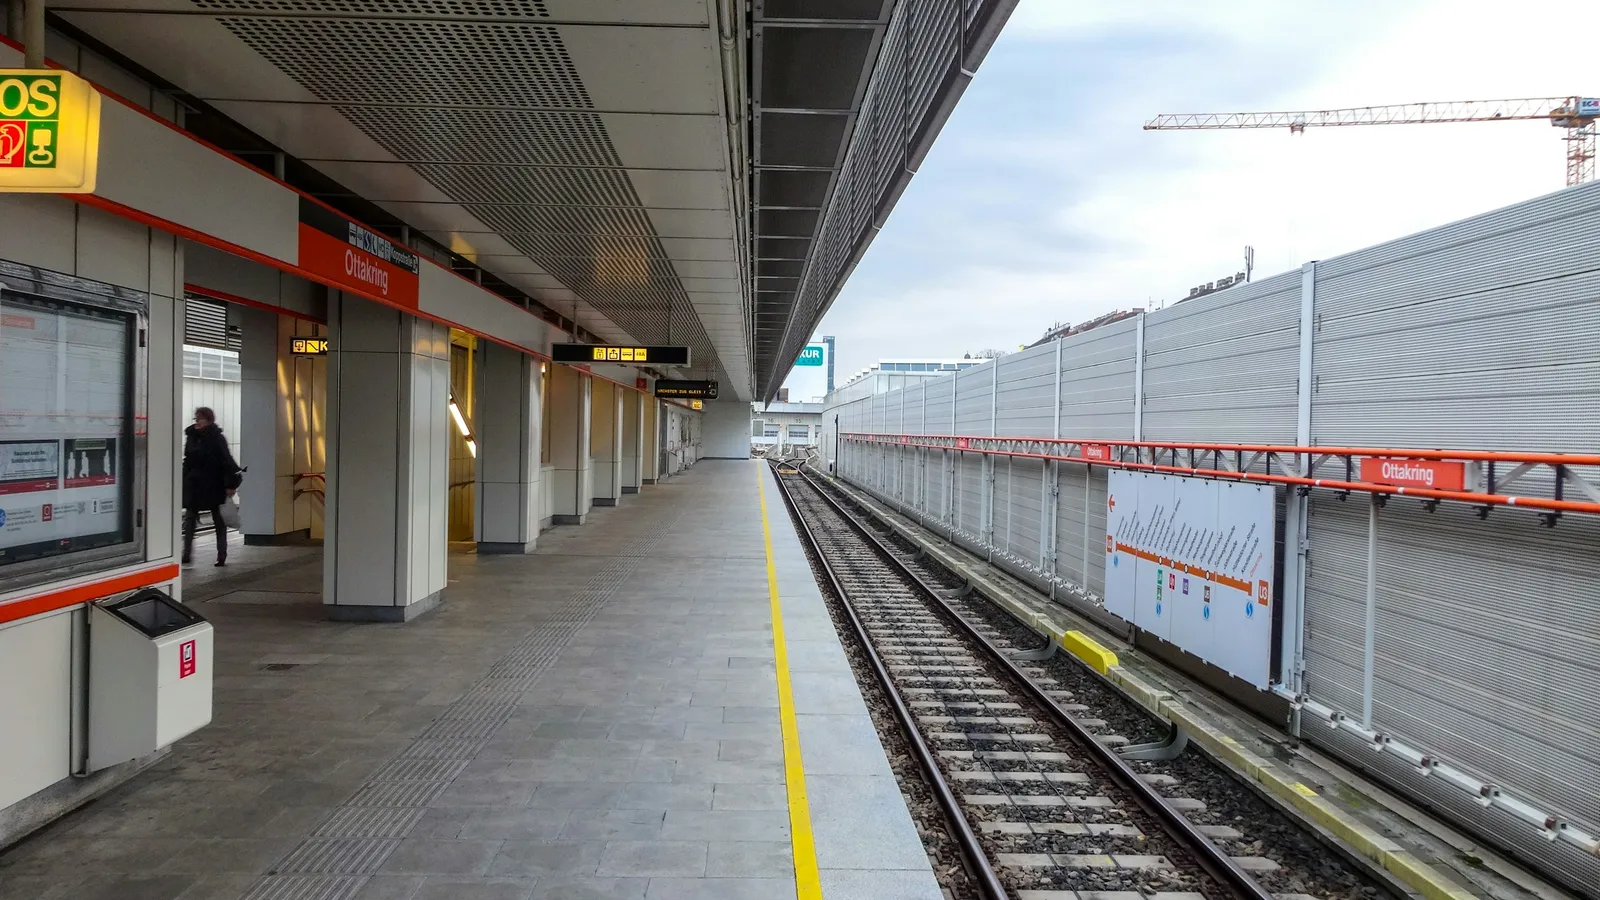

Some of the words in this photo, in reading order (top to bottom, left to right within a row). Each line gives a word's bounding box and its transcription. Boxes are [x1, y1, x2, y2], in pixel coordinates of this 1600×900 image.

[0, 79, 57, 117] OS
[345, 249, 388, 295] Ottakring
[1382, 462, 1433, 485] Ottakring
[1259, 585, 1268, 600] U3
